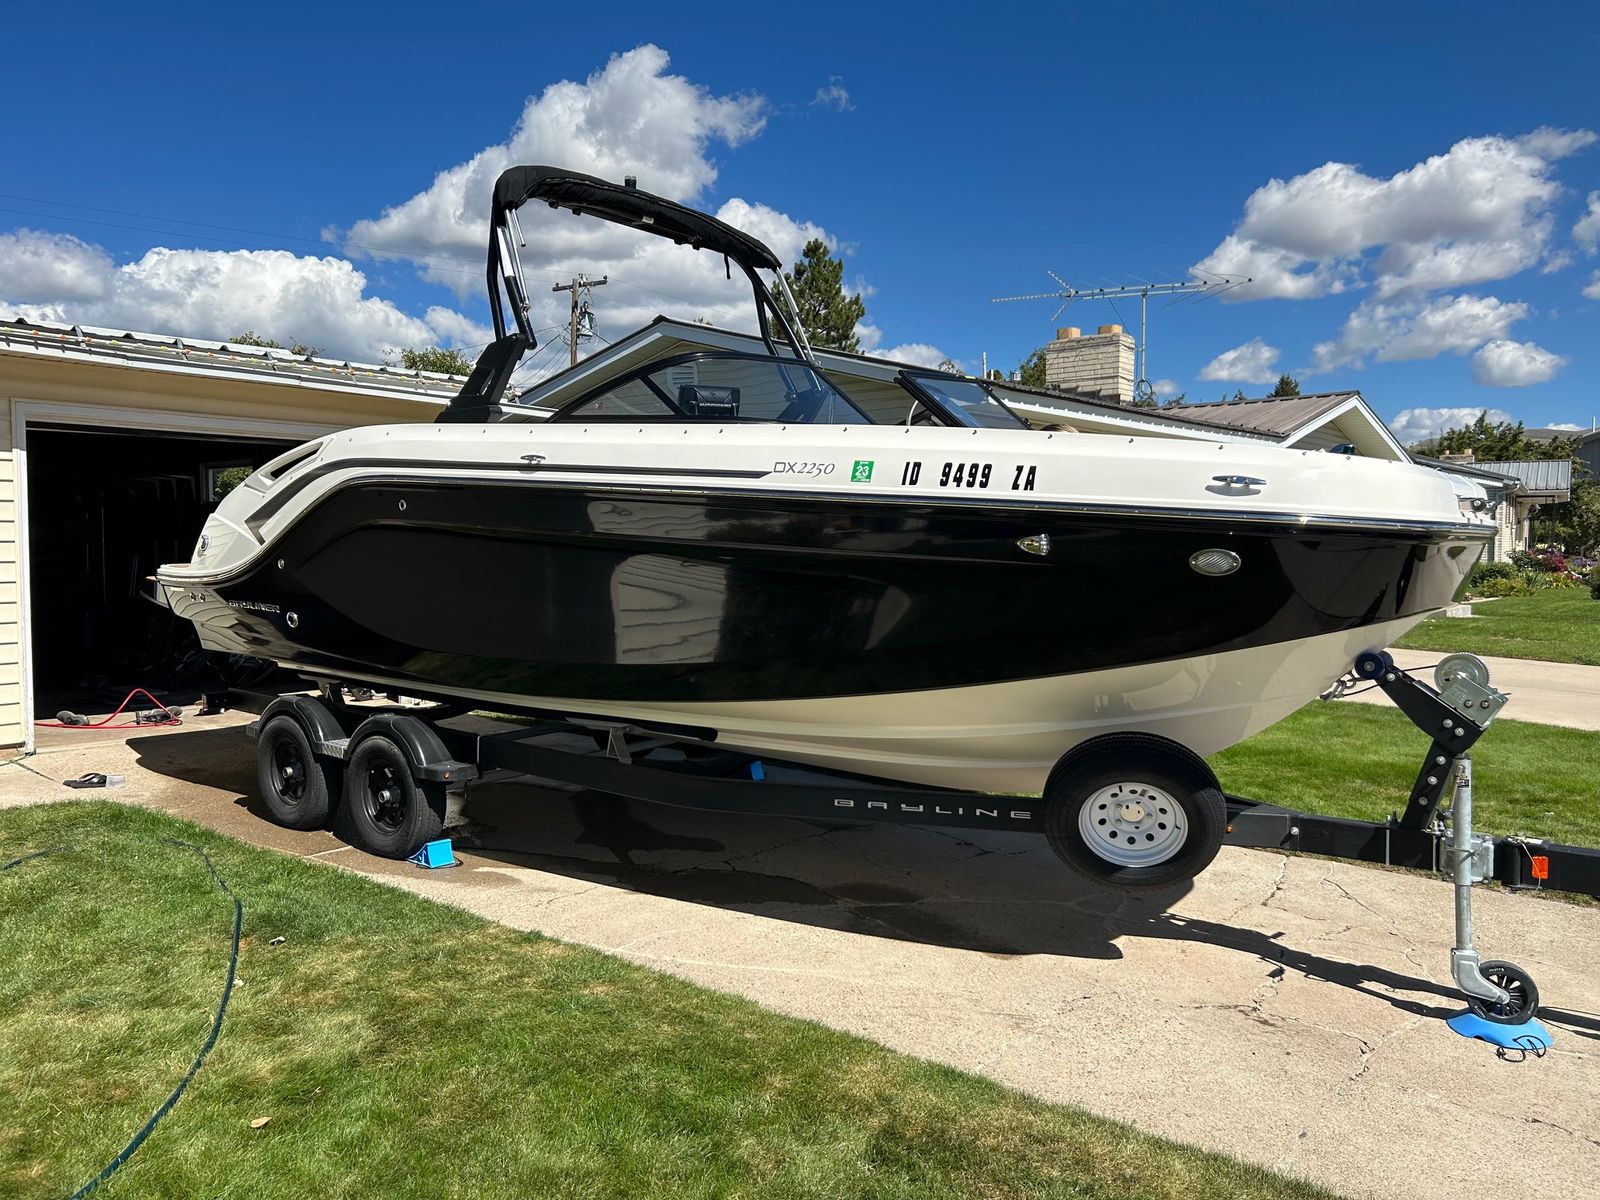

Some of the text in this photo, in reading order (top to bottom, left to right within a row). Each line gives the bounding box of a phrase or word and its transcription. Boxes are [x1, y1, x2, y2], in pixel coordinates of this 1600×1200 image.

[773, 461, 835, 476] DX2250
[855, 465, 869, 477] 23
[901, 461, 1037, 491] ID 9499 ZA
[228, 600, 281, 613] BAYLINER
[834, 798, 1032, 819] BAYLINE
